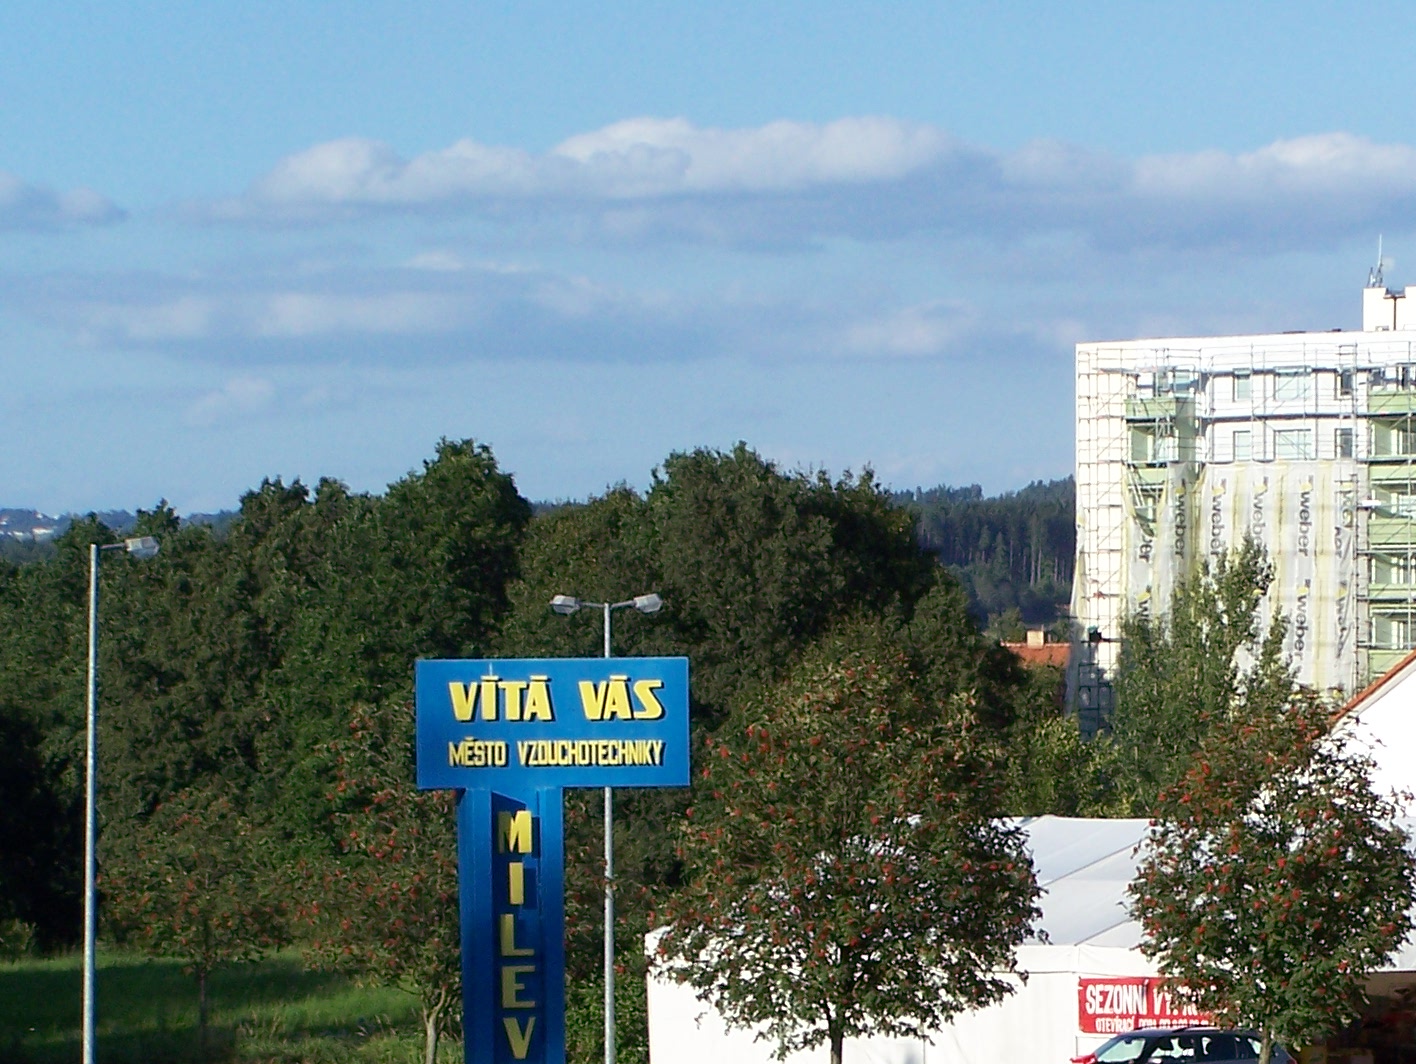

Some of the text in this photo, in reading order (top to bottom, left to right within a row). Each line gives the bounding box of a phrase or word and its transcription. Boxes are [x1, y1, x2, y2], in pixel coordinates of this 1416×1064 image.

[1298, 491, 1312, 557] weber
[1294, 595, 1309, 660] weber
[516, 739, 664, 767] VZDUCHOTECHNIKY
[1085, 978, 1149, 1016] SEZONNÍ
